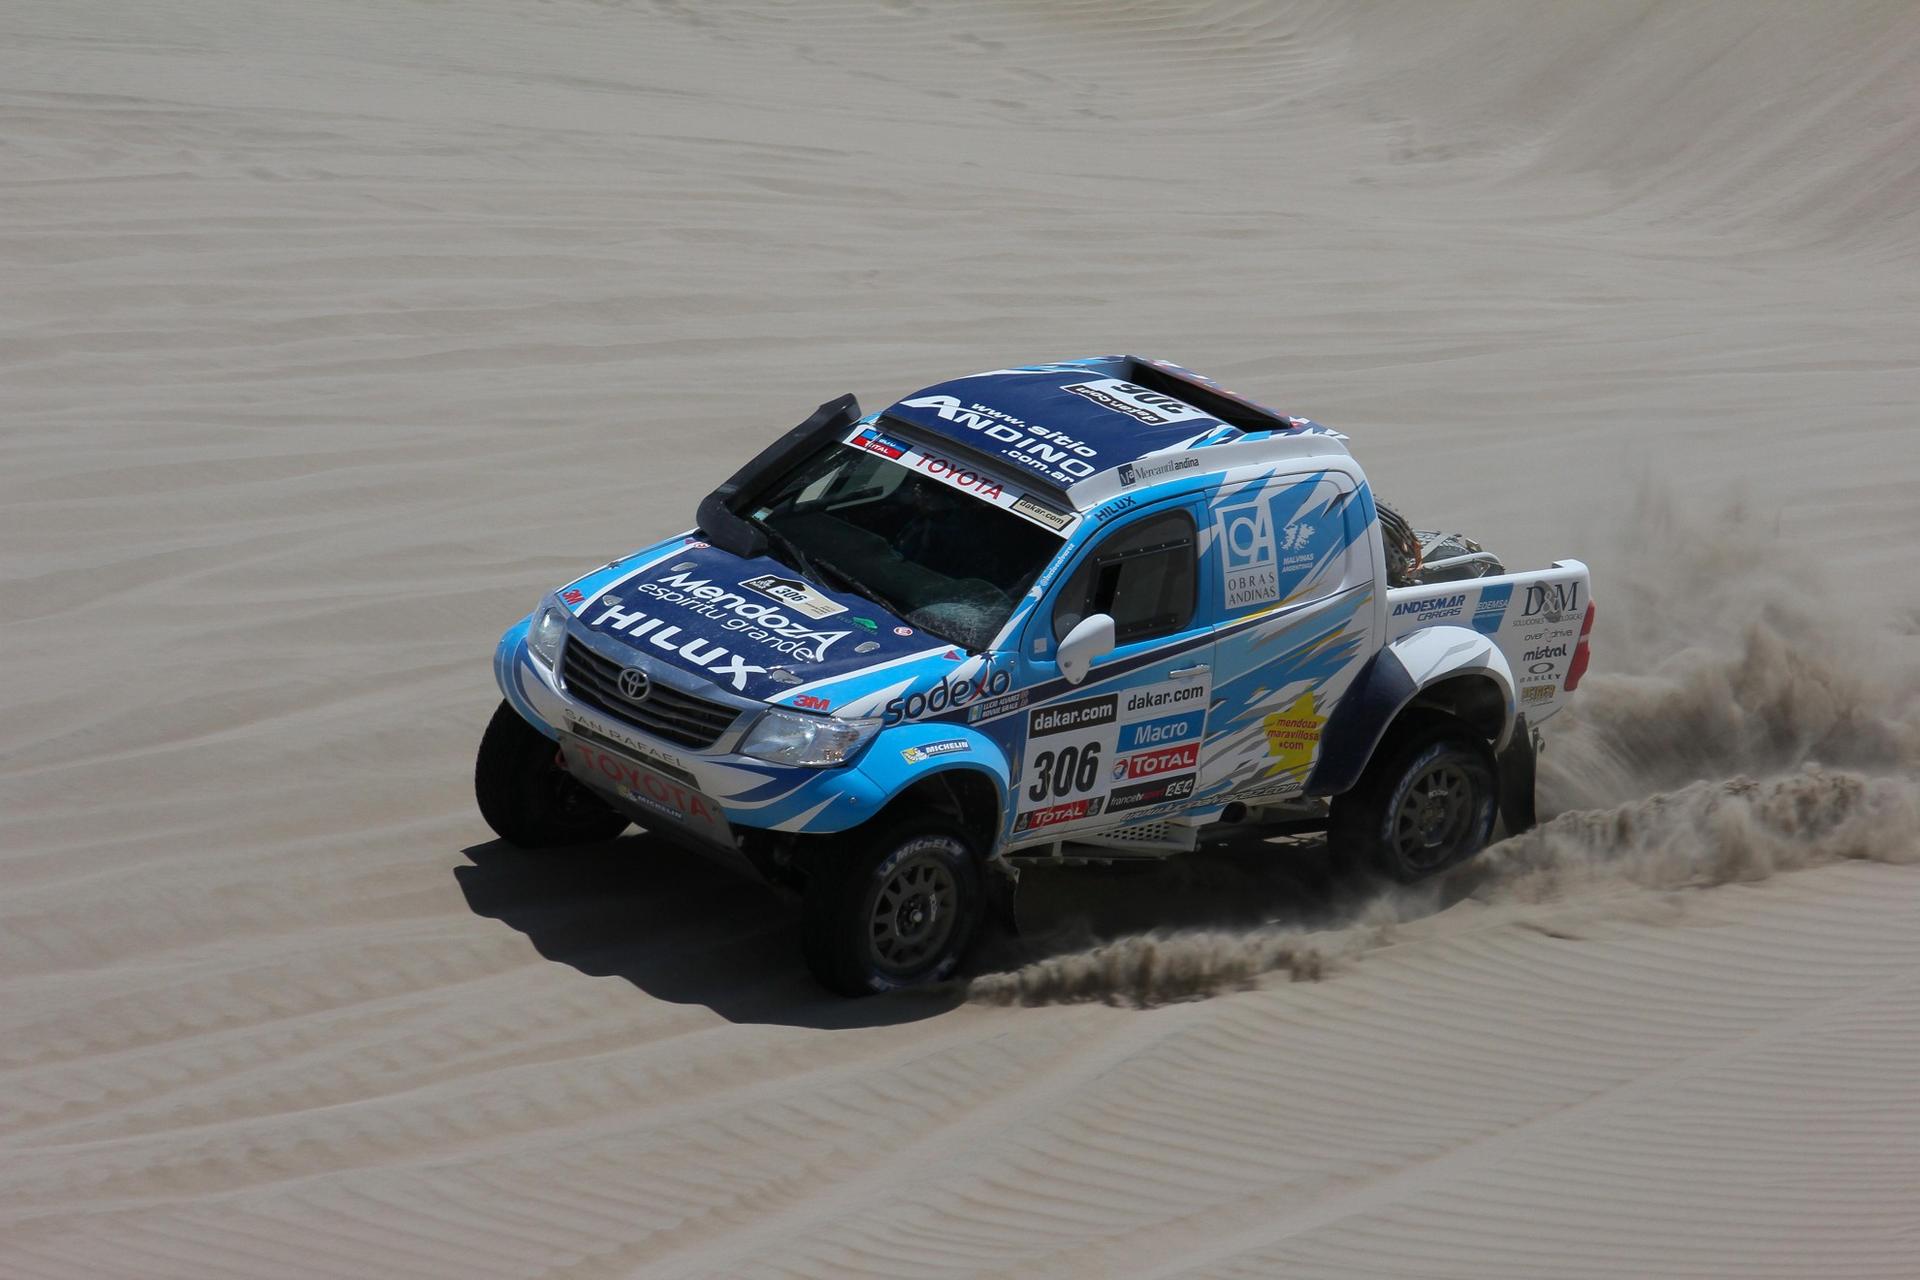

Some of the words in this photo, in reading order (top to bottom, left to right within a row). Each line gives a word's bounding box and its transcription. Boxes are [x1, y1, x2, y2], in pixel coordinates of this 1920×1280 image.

[900, 395, 1097, 478] ANDINO
[1000, 448, 1077, 485] .com.ar
[1174, 456, 1200, 471] andina
[914, 452, 1005, 501] TOYOTA
[1018, 498, 1065, 526] dakar.com
[1094, 495, 1137, 521] HILUX
[1227, 571, 1276, 591] OBRAS
[562, 588, 587, 606] 3M
[774, 587, 809, 602] 306
[1228, 586, 1276, 606] ANDINAS
[1392, 594, 1467, 617] ANDESMAR
[1520, 580, 1581, 618] D&M
[1417, 607, 1463, 622] CARGAS
[591, 604, 768, 692] HILUX
[720, 618, 813, 662] grande
[1522, 643, 1567, 661] mistral
[792, 692, 831, 711] 3M
[884, 666, 1012, 726] sodexo
[1127, 685, 1204, 712] dakar.com
[1034, 702, 1113, 731] dakar.com
[1278, 718, 1319, 729] mendoza
[564, 708, 603, 733] SAN
[608, 729, 688, 771] RAFAEL
[1133, 721, 1189, 745] Macro
[1266, 729, 1320, 741] maravillosa
[925, 741, 969, 754] MICHELIN
[1028, 741, 1102, 803] 306
[1133, 752, 1194, 773] TOTAL
[573, 742, 716, 826] TOYOTA
[1034, 808, 1084, 824] TOTAL
